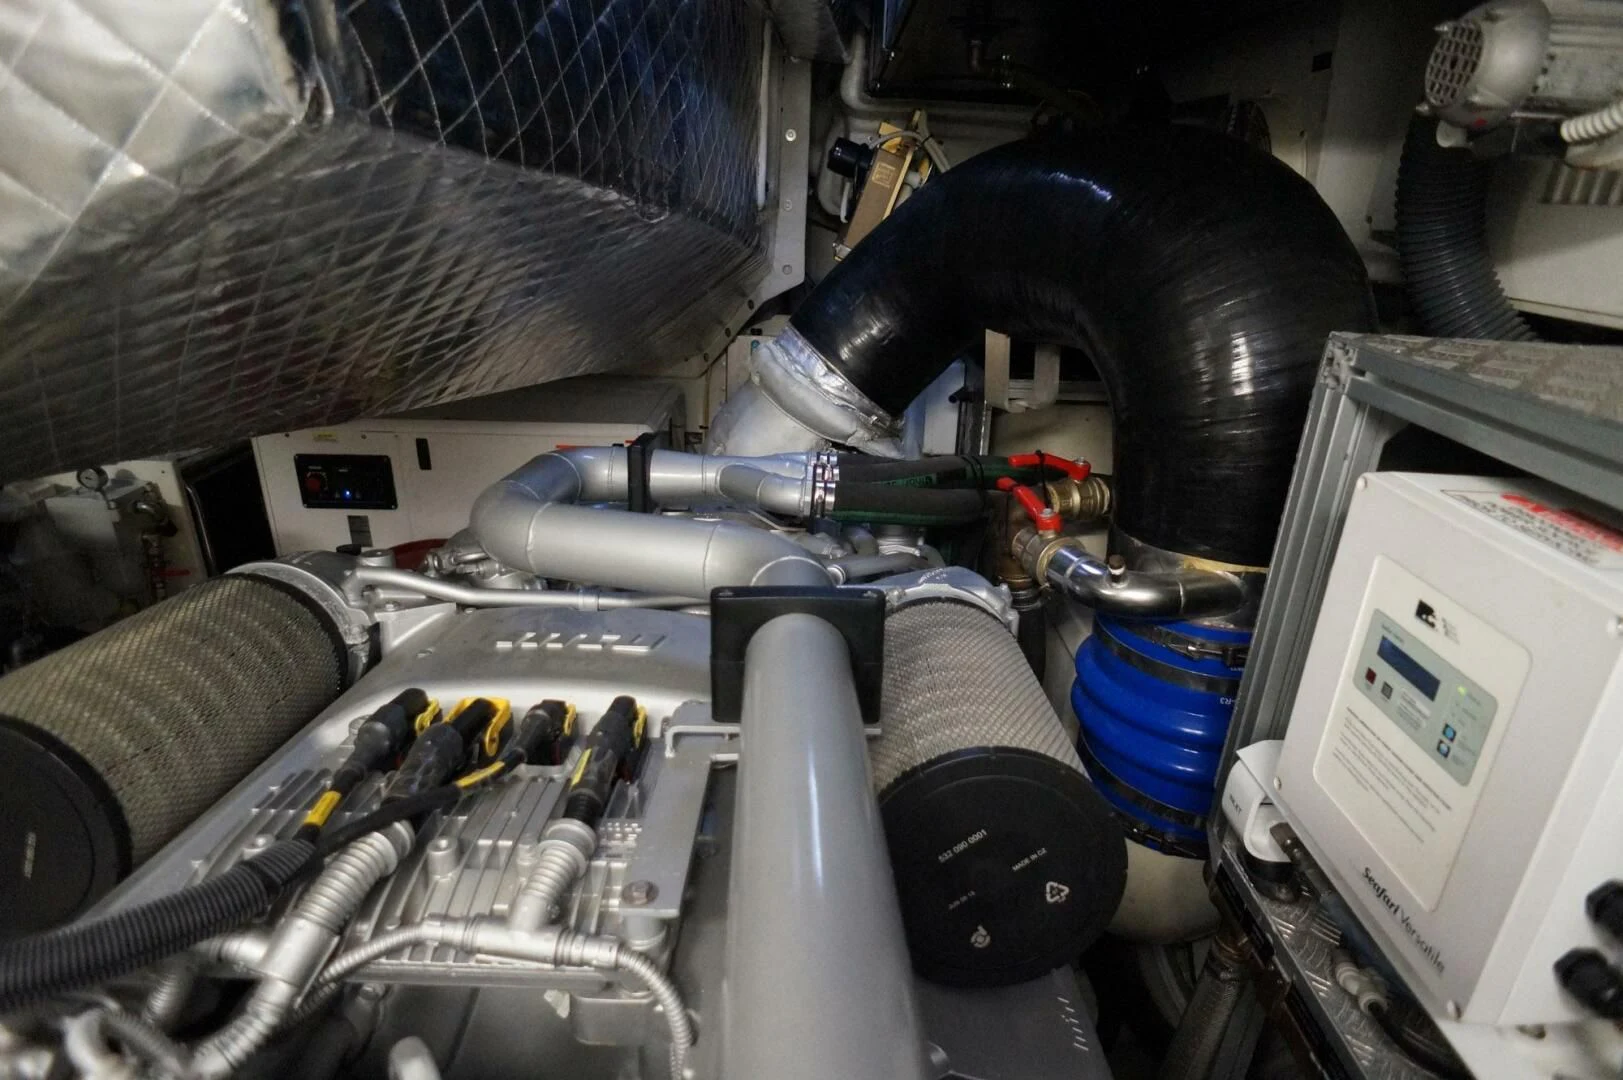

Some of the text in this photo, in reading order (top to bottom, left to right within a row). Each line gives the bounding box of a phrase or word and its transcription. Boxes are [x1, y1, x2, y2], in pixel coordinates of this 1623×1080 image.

[967, 828, 988, 844] 0001
[1362, 867, 1446, 973] Seafari Versatile
